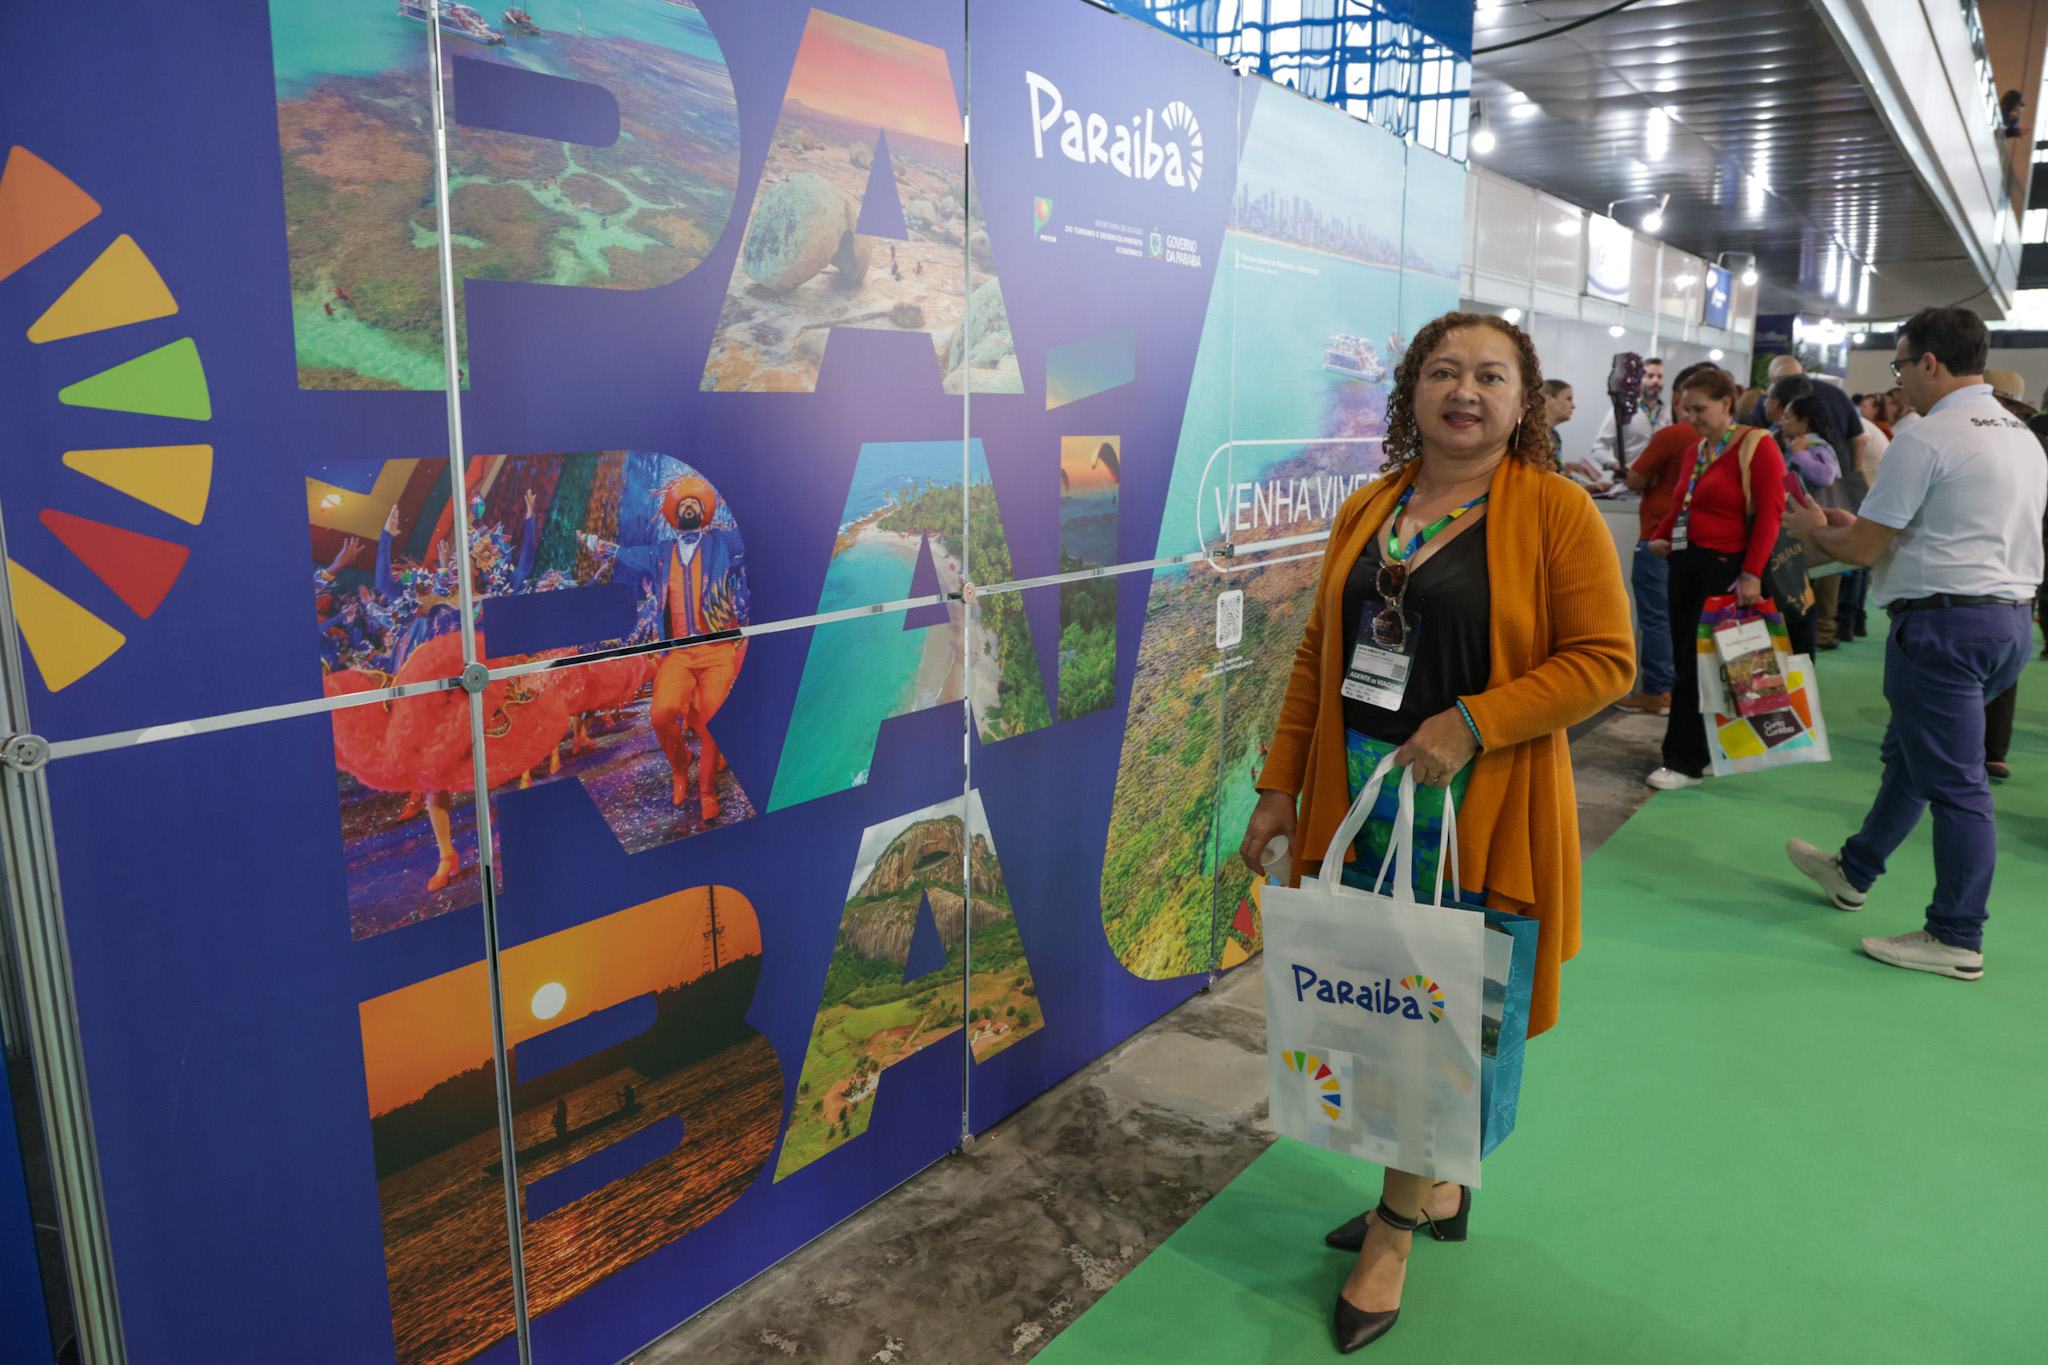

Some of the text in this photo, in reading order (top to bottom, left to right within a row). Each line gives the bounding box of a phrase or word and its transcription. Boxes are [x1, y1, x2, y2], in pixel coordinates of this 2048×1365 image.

[1064, 224, 1073, 234] DO
[1073, 226, 1096, 238] TURISMO
[1166, 234, 1198, 254] GOVERNO
[1166, 248, 1176, 263] DA
[1970, 417, 2002, 427] Sec.
[1215, 477, 1312, 536] VENHA
[1349, 671, 1372, 683] AGENTE
[1376, 677, 1402, 691] VIAGENS
